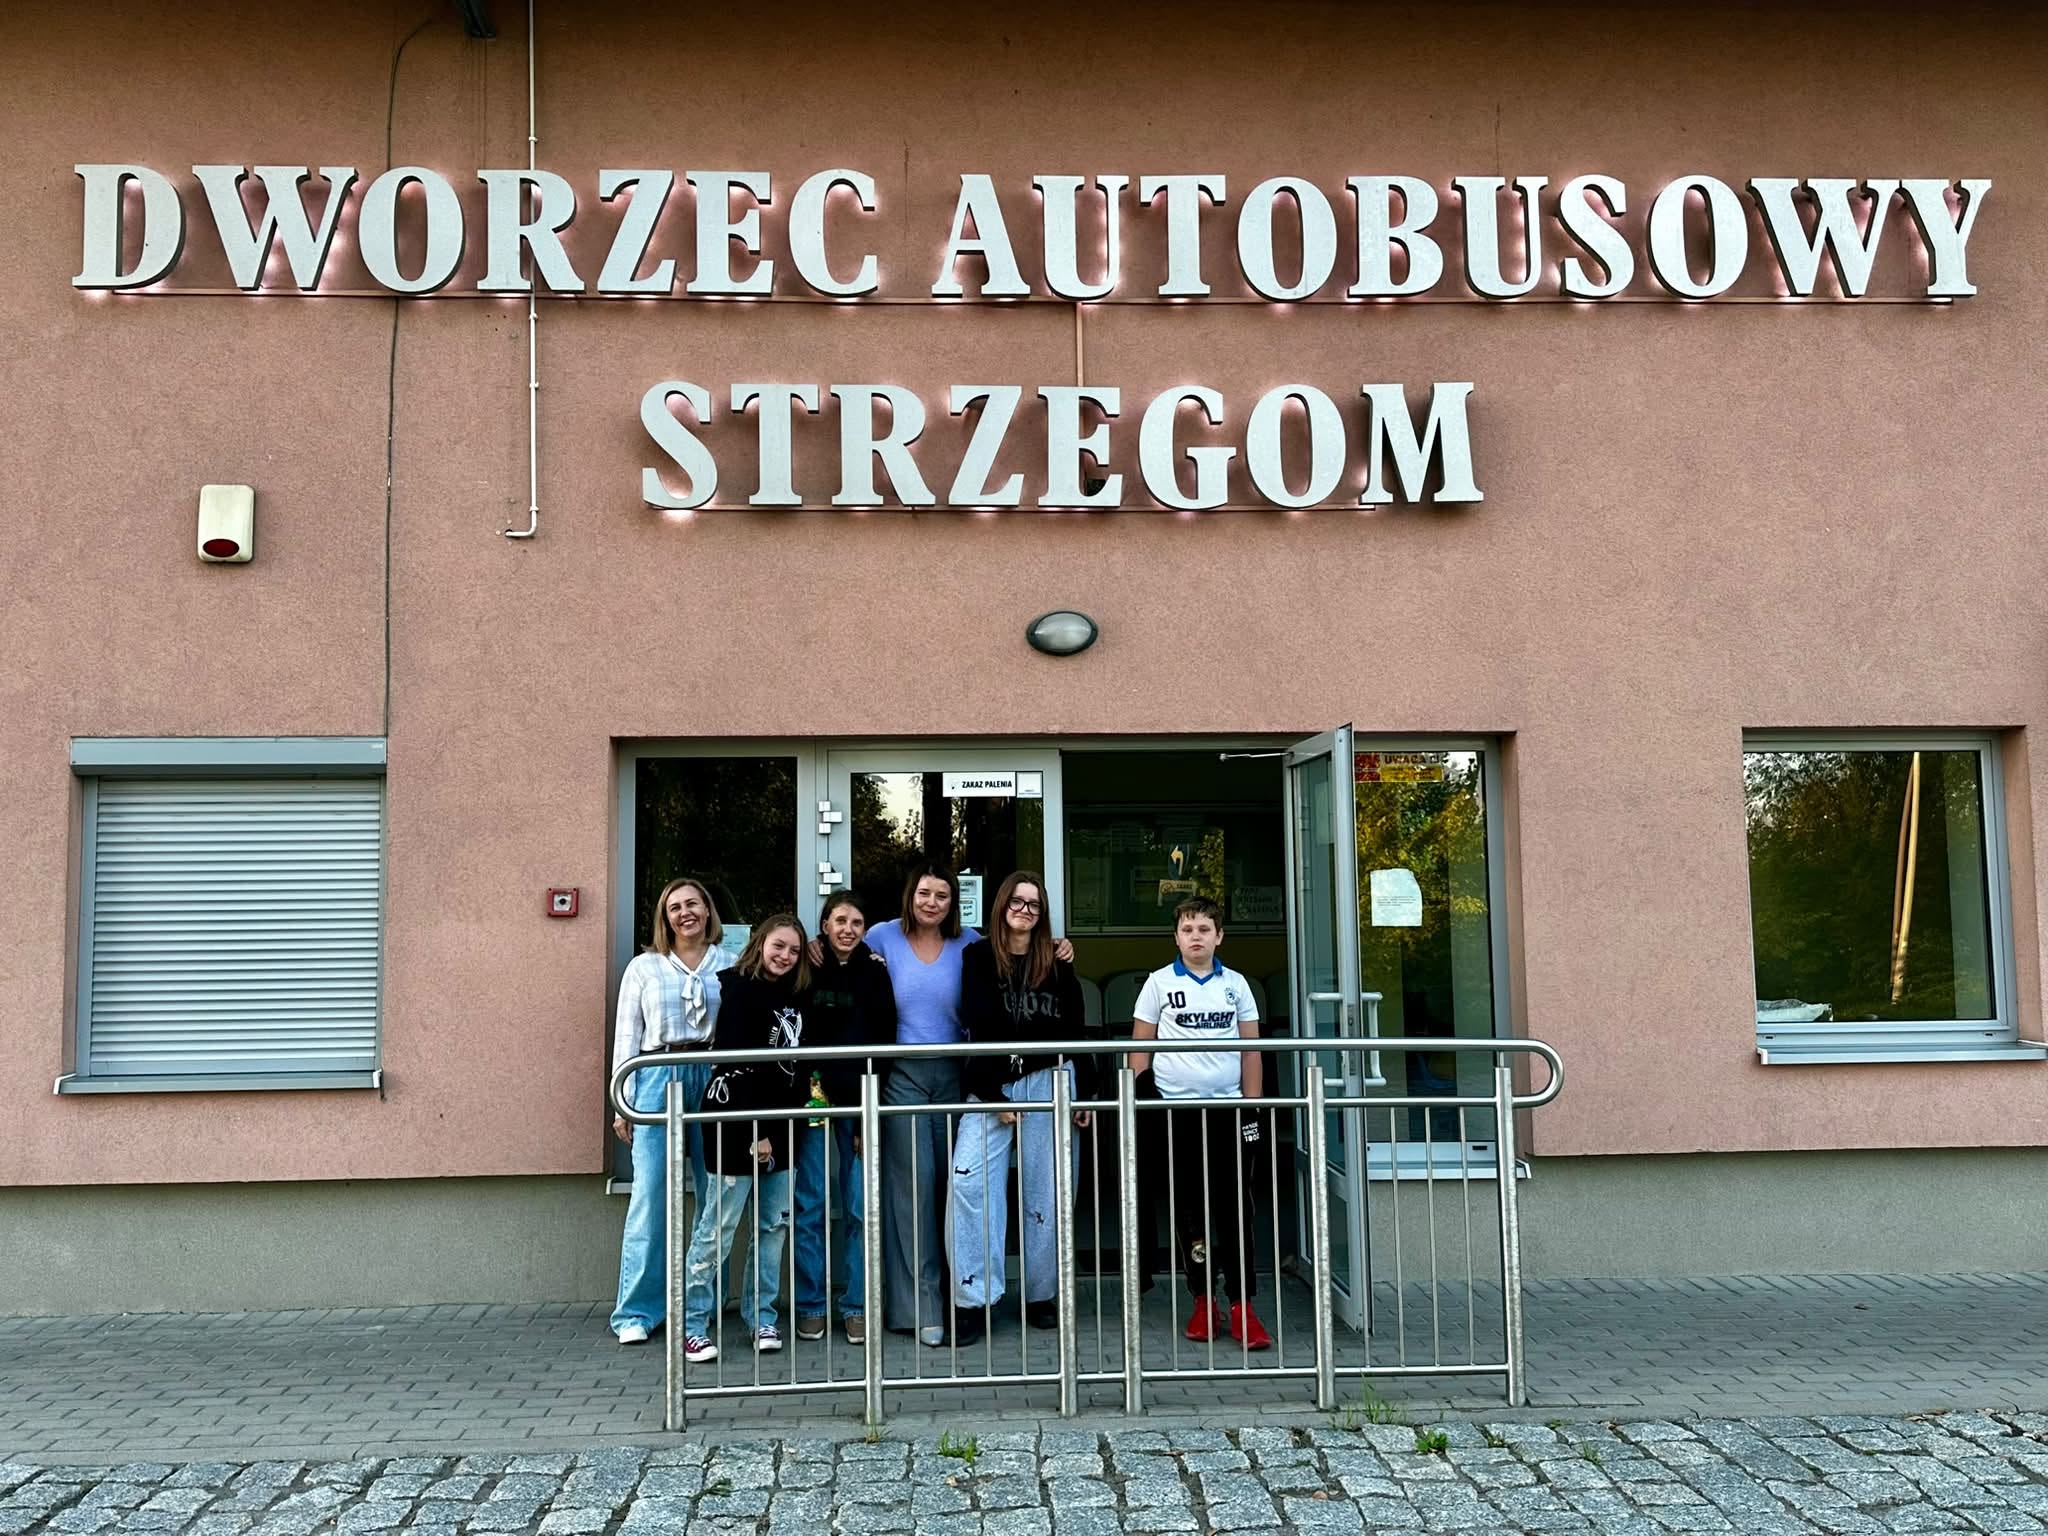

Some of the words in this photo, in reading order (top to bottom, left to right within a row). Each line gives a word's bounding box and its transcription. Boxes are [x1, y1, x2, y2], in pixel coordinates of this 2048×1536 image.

[72, 164, 878, 298] DWORZEC
[932, 174, 1992, 300] AUTOBUSOWY
[640, 380, 1484, 510] STRZEGOM
[962, 780, 983, 789] ZAKAZ
[985, 780, 1012, 788] PALENIA
[1167, 990, 1186, 1009] 10
[1175, 1011, 1235, 1024] SKYLIGHT
[1195, 1021, 1231, 1029] AIRLINES
